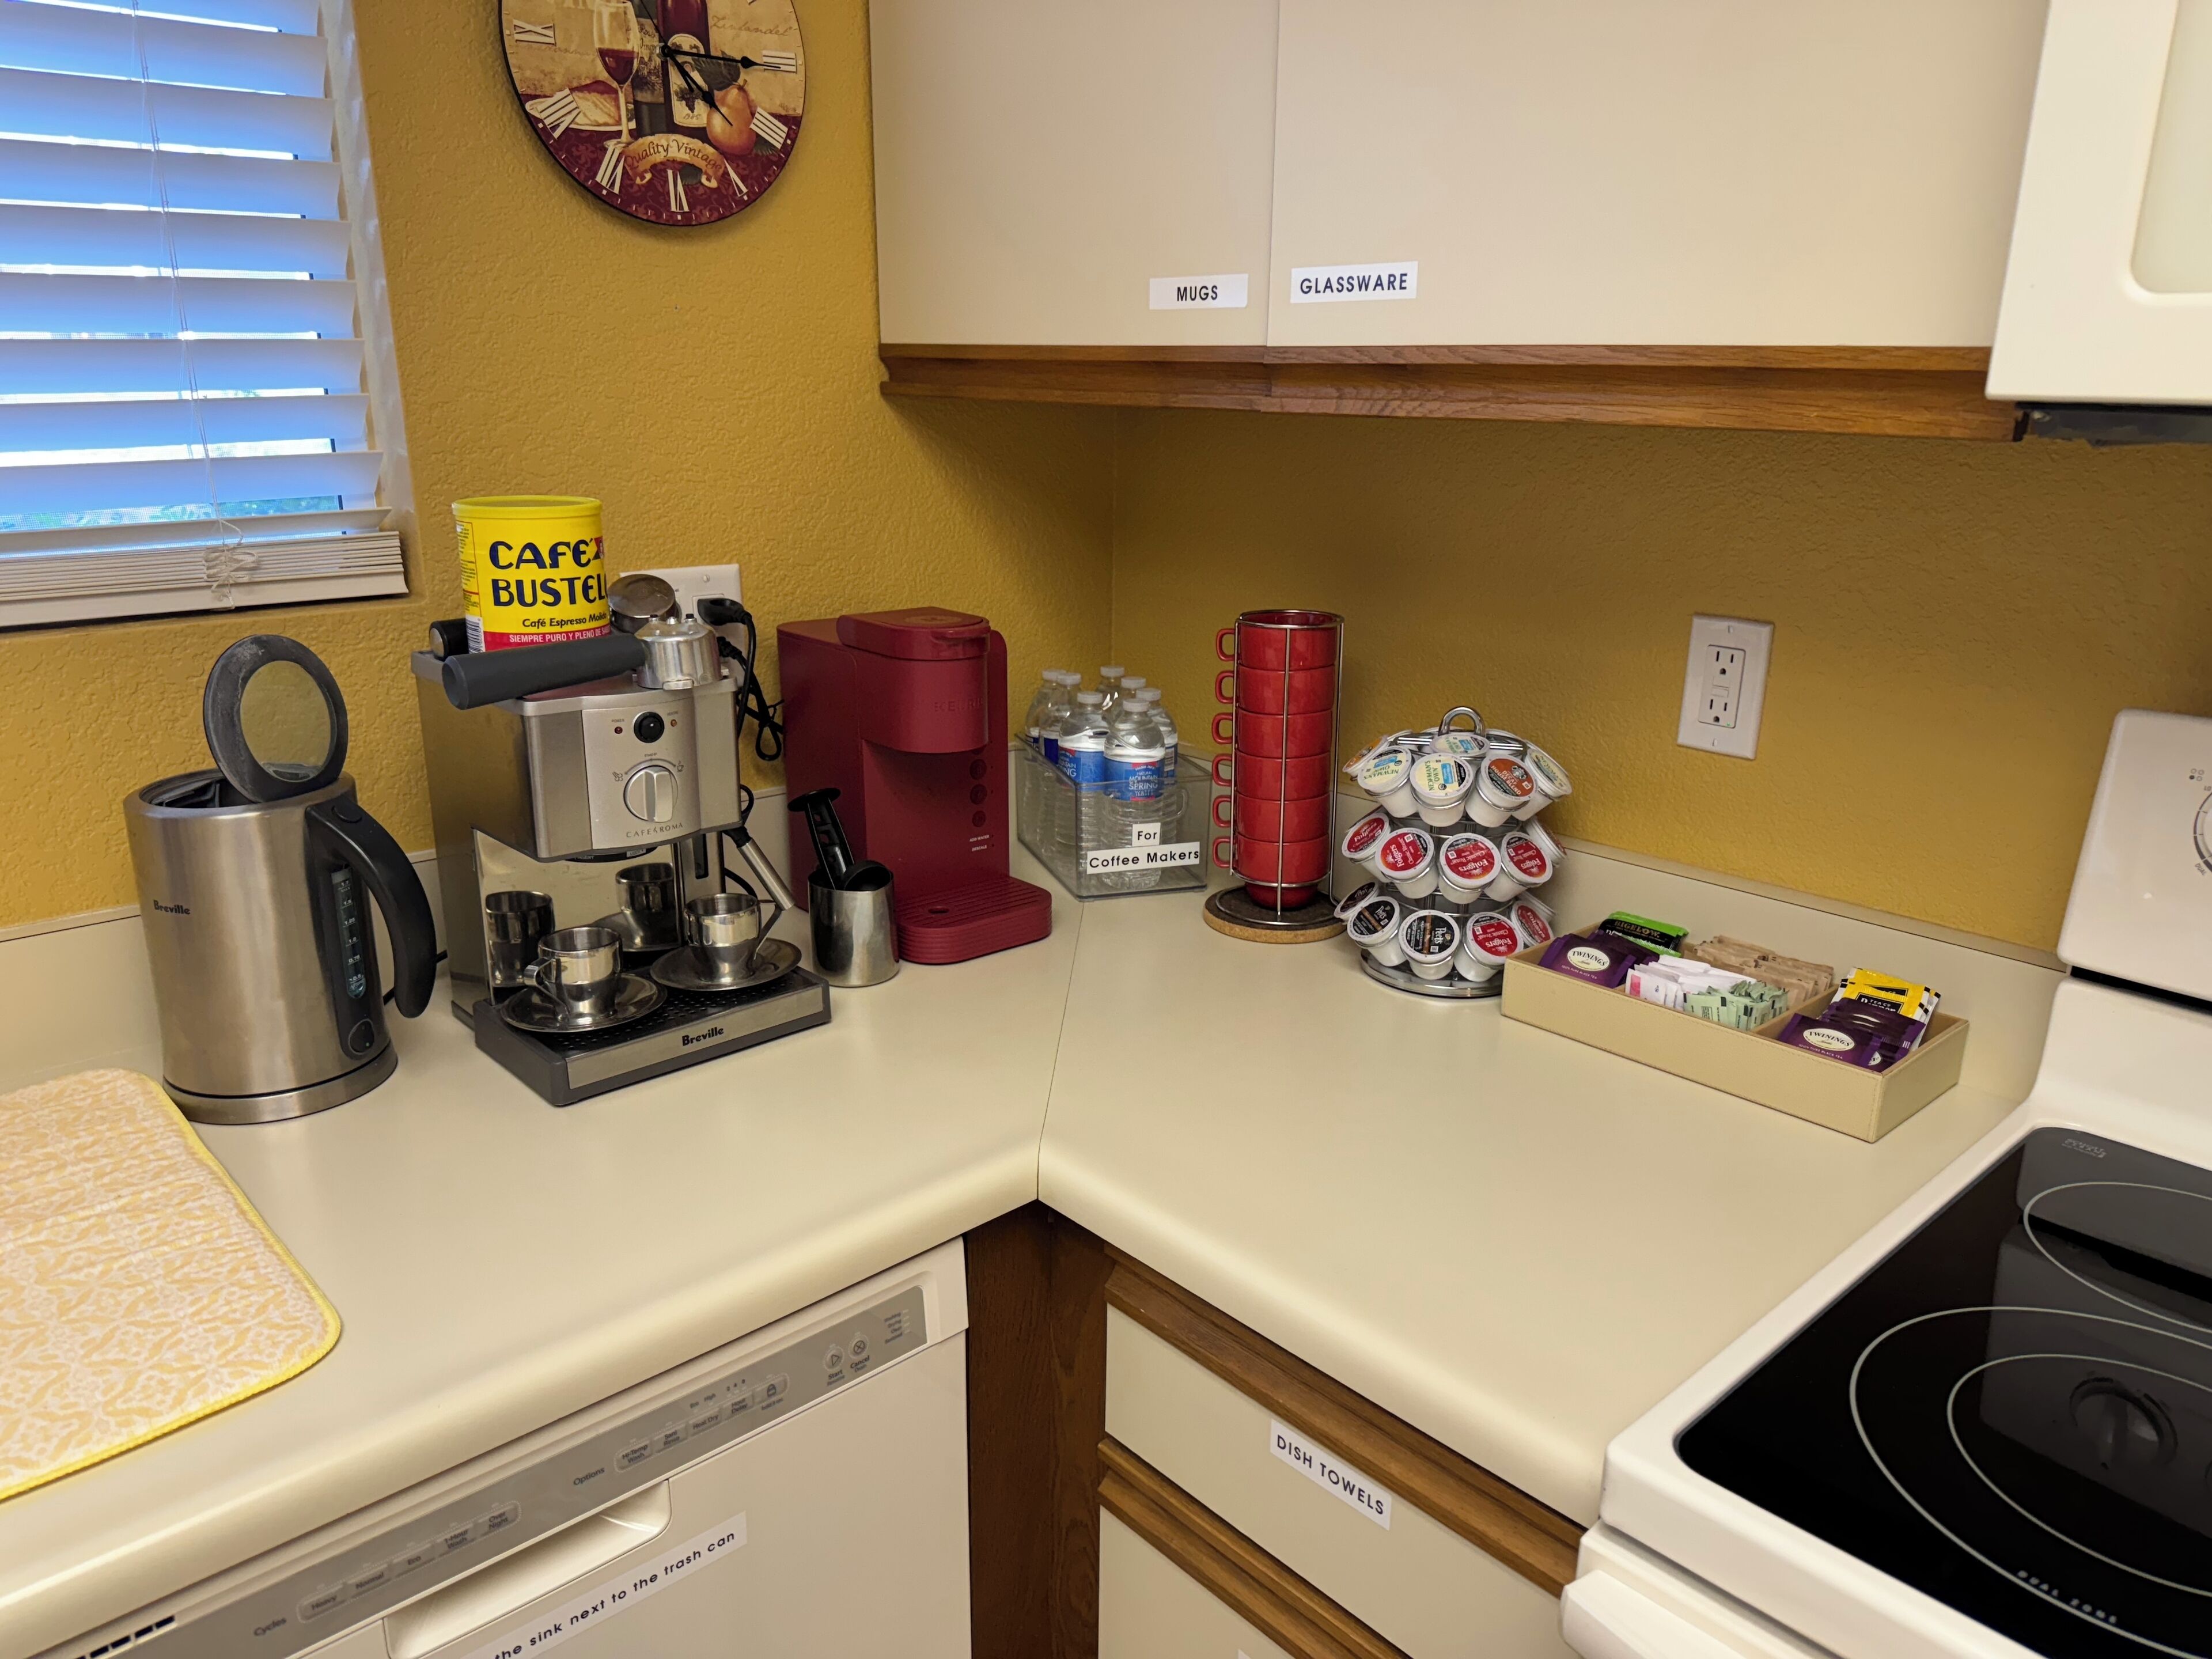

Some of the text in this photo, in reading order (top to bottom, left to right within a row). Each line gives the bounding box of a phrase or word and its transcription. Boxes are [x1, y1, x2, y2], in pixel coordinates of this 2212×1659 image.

[625, 139, 722, 170] Quality Vintage
[1300, 273, 1408, 295] GLASSWARE
[1176, 285, 1218, 302] MUGS
[489, 538, 593, 570] CAFÉ
[491, 573, 608, 608] BUSTEL
[522, 618, 546, 629] Café
[550, 618, 586, 628] Espresso
[509, 634, 543, 643] SIEMPRE
[546, 633, 567, 642] PURO
[569, 632, 575, 641] Y
[575, 630, 594, 640] PLENO
[595, 628, 601, 637] DE
[1129, 782, 1158, 790] SPRING
[1506, 779, 1521, 796] BLEND
[626, 822, 684, 838] CAFE ROMA
[1137, 831, 1157, 840] For
[1089, 851, 1199, 868] Coffee Makers
[1390, 844, 1404, 868] Folgers
[1521, 858, 1541, 869] Folgers
[1459, 859, 1488, 872] Folgers
[153, 900, 191, 915] Breville
[1485, 938, 1512, 948] Folgers
[1572, 950, 1607, 967] TWININGS
[682, 1027, 724, 1046] Breville
[1808, 1031, 1850, 1047] TWININGS
[850, 1355, 869, 1369] Cancel
[828, 1369, 842, 1380] Start
[704, 1393, 716, 1402] High
[731, 1397, 745, 1408] Hour
[731, 1403, 748, 1414] Delay
[693, 1414, 719, 1430] Heat Dry
[664, 1429, 677, 1440] Sani
[622, 1444, 648, 1460] Hi-Temp
[627, 1453, 645, 1464] Wash
[573, 1467, 605, 1485] Options
[1277, 1434, 1384, 1515] DISH TOWELS
[488, 1511, 506, 1522] Over
[488, 1517, 508, 1530] Night
[445, 1529, 469, 1544] 1-Hour
[447, 1537, 467, 1549] Wash
[407, 1556, 421, 1565] Eco
[355, 1571, 384, 1589] Normal
[312, 1595, 337, 1611] Heavy
[495, 1532, 734, 1659] the sink next to the trash can
[253, 1618, 287, 1637] Cycles
